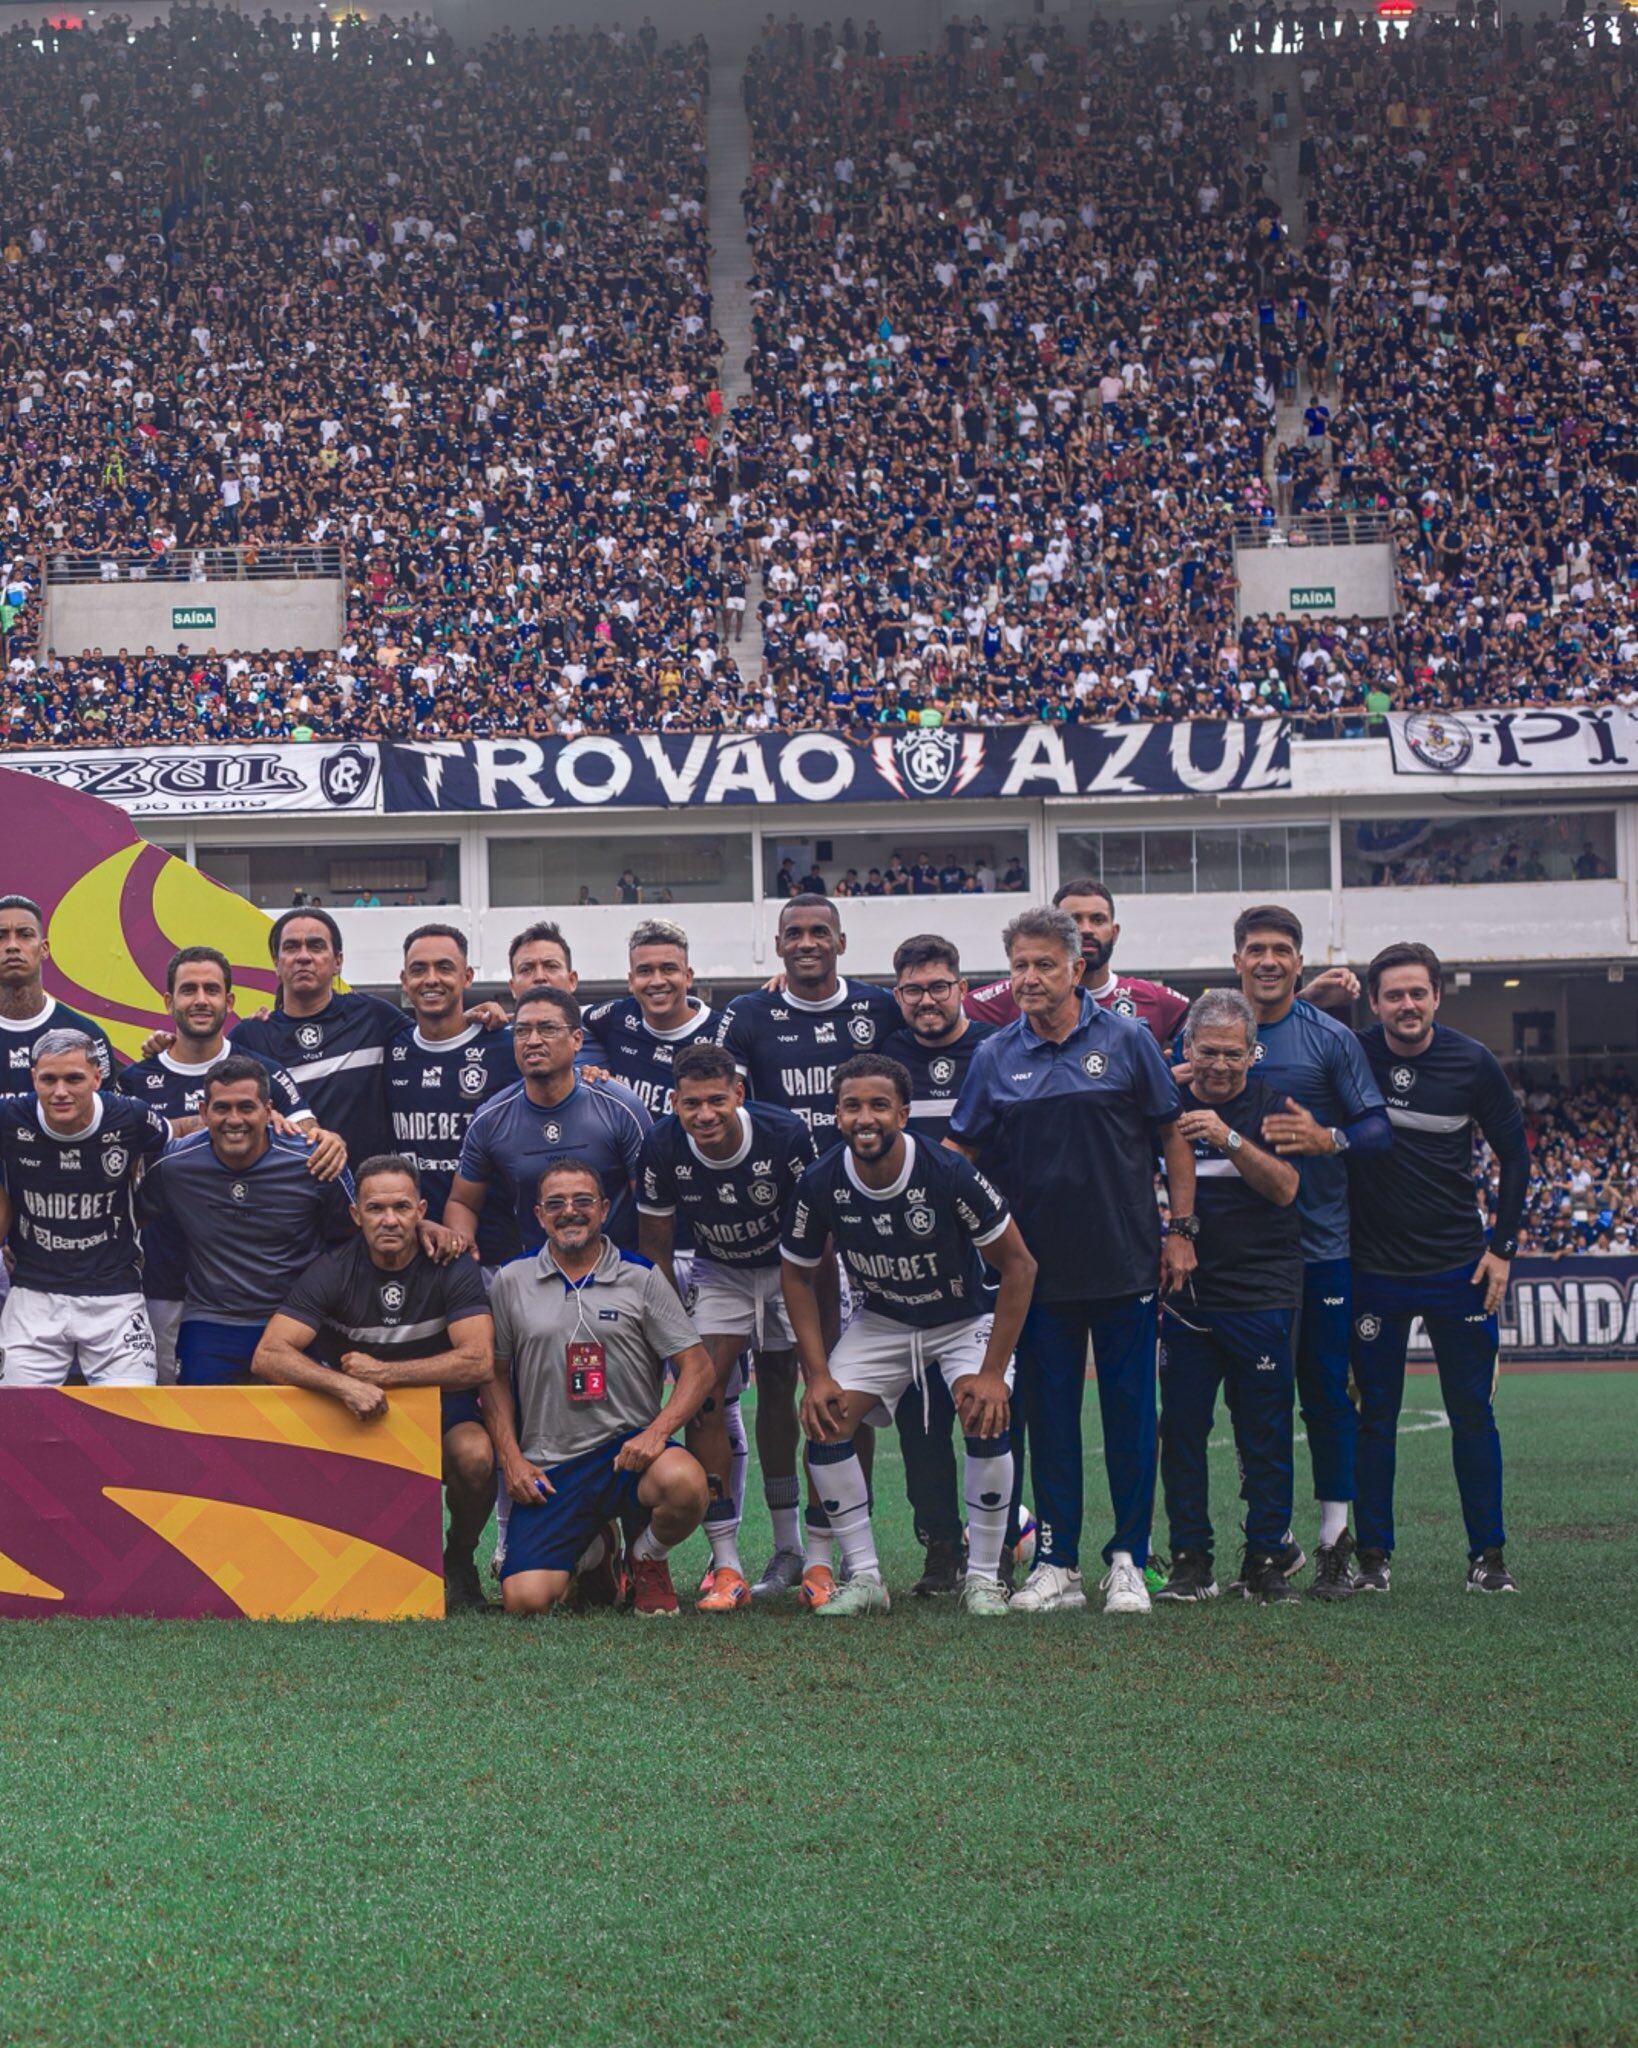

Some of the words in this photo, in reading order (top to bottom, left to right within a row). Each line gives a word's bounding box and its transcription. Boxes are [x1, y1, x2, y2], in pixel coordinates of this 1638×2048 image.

[1292, 590, 1333, 605] SAÍDA
[174, 611, 214, 624] SAÍDA
[1475, 710, 1638, 767] PI
[394, 733, 854, 808] TROVÃO
[1000, 718, 1291, 796] AZUL
